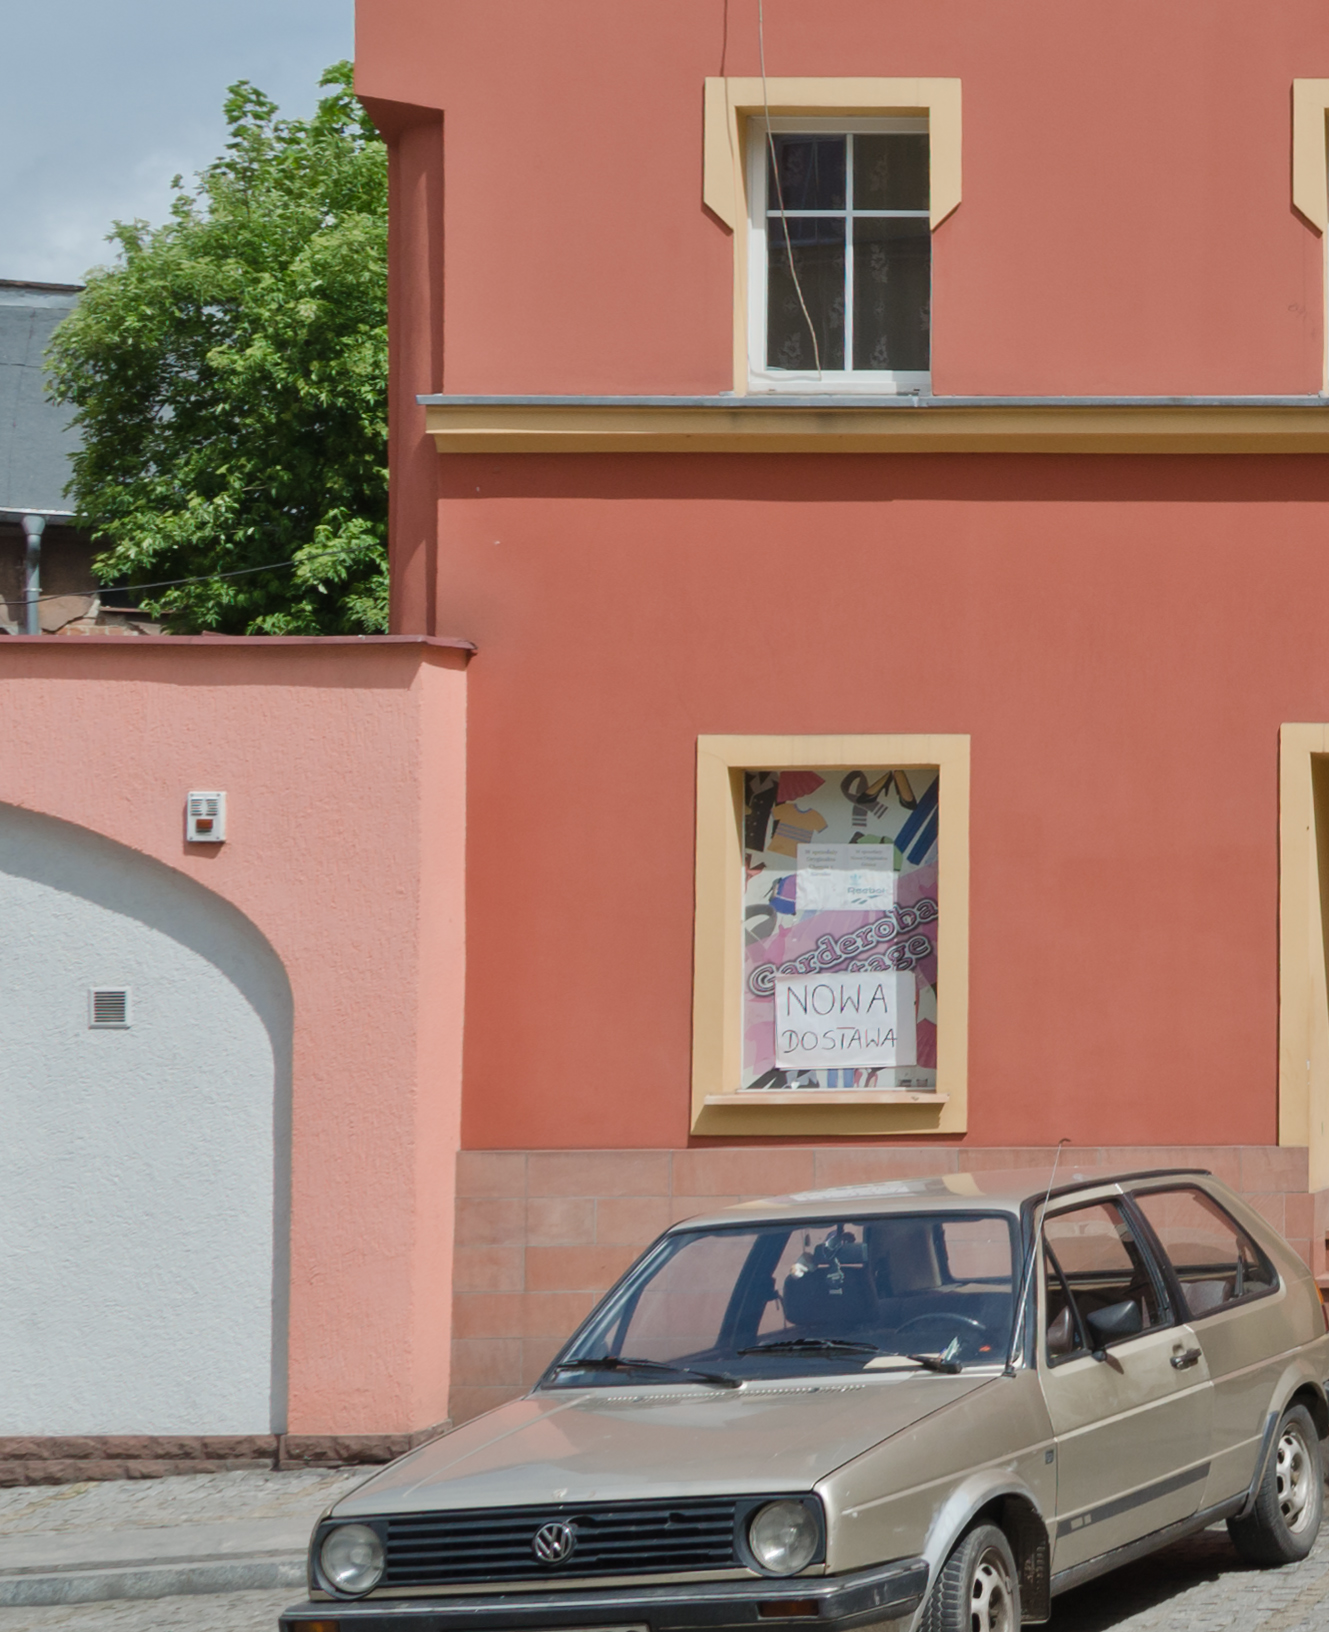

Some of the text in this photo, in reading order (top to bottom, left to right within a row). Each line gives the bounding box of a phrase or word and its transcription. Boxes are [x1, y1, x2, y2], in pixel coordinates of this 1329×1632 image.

[750, 898, 939, 996] Garderoba
[786, 982, 888, 1016] NOWA
[782, 1025, 898, 1054] DOSTAWA
